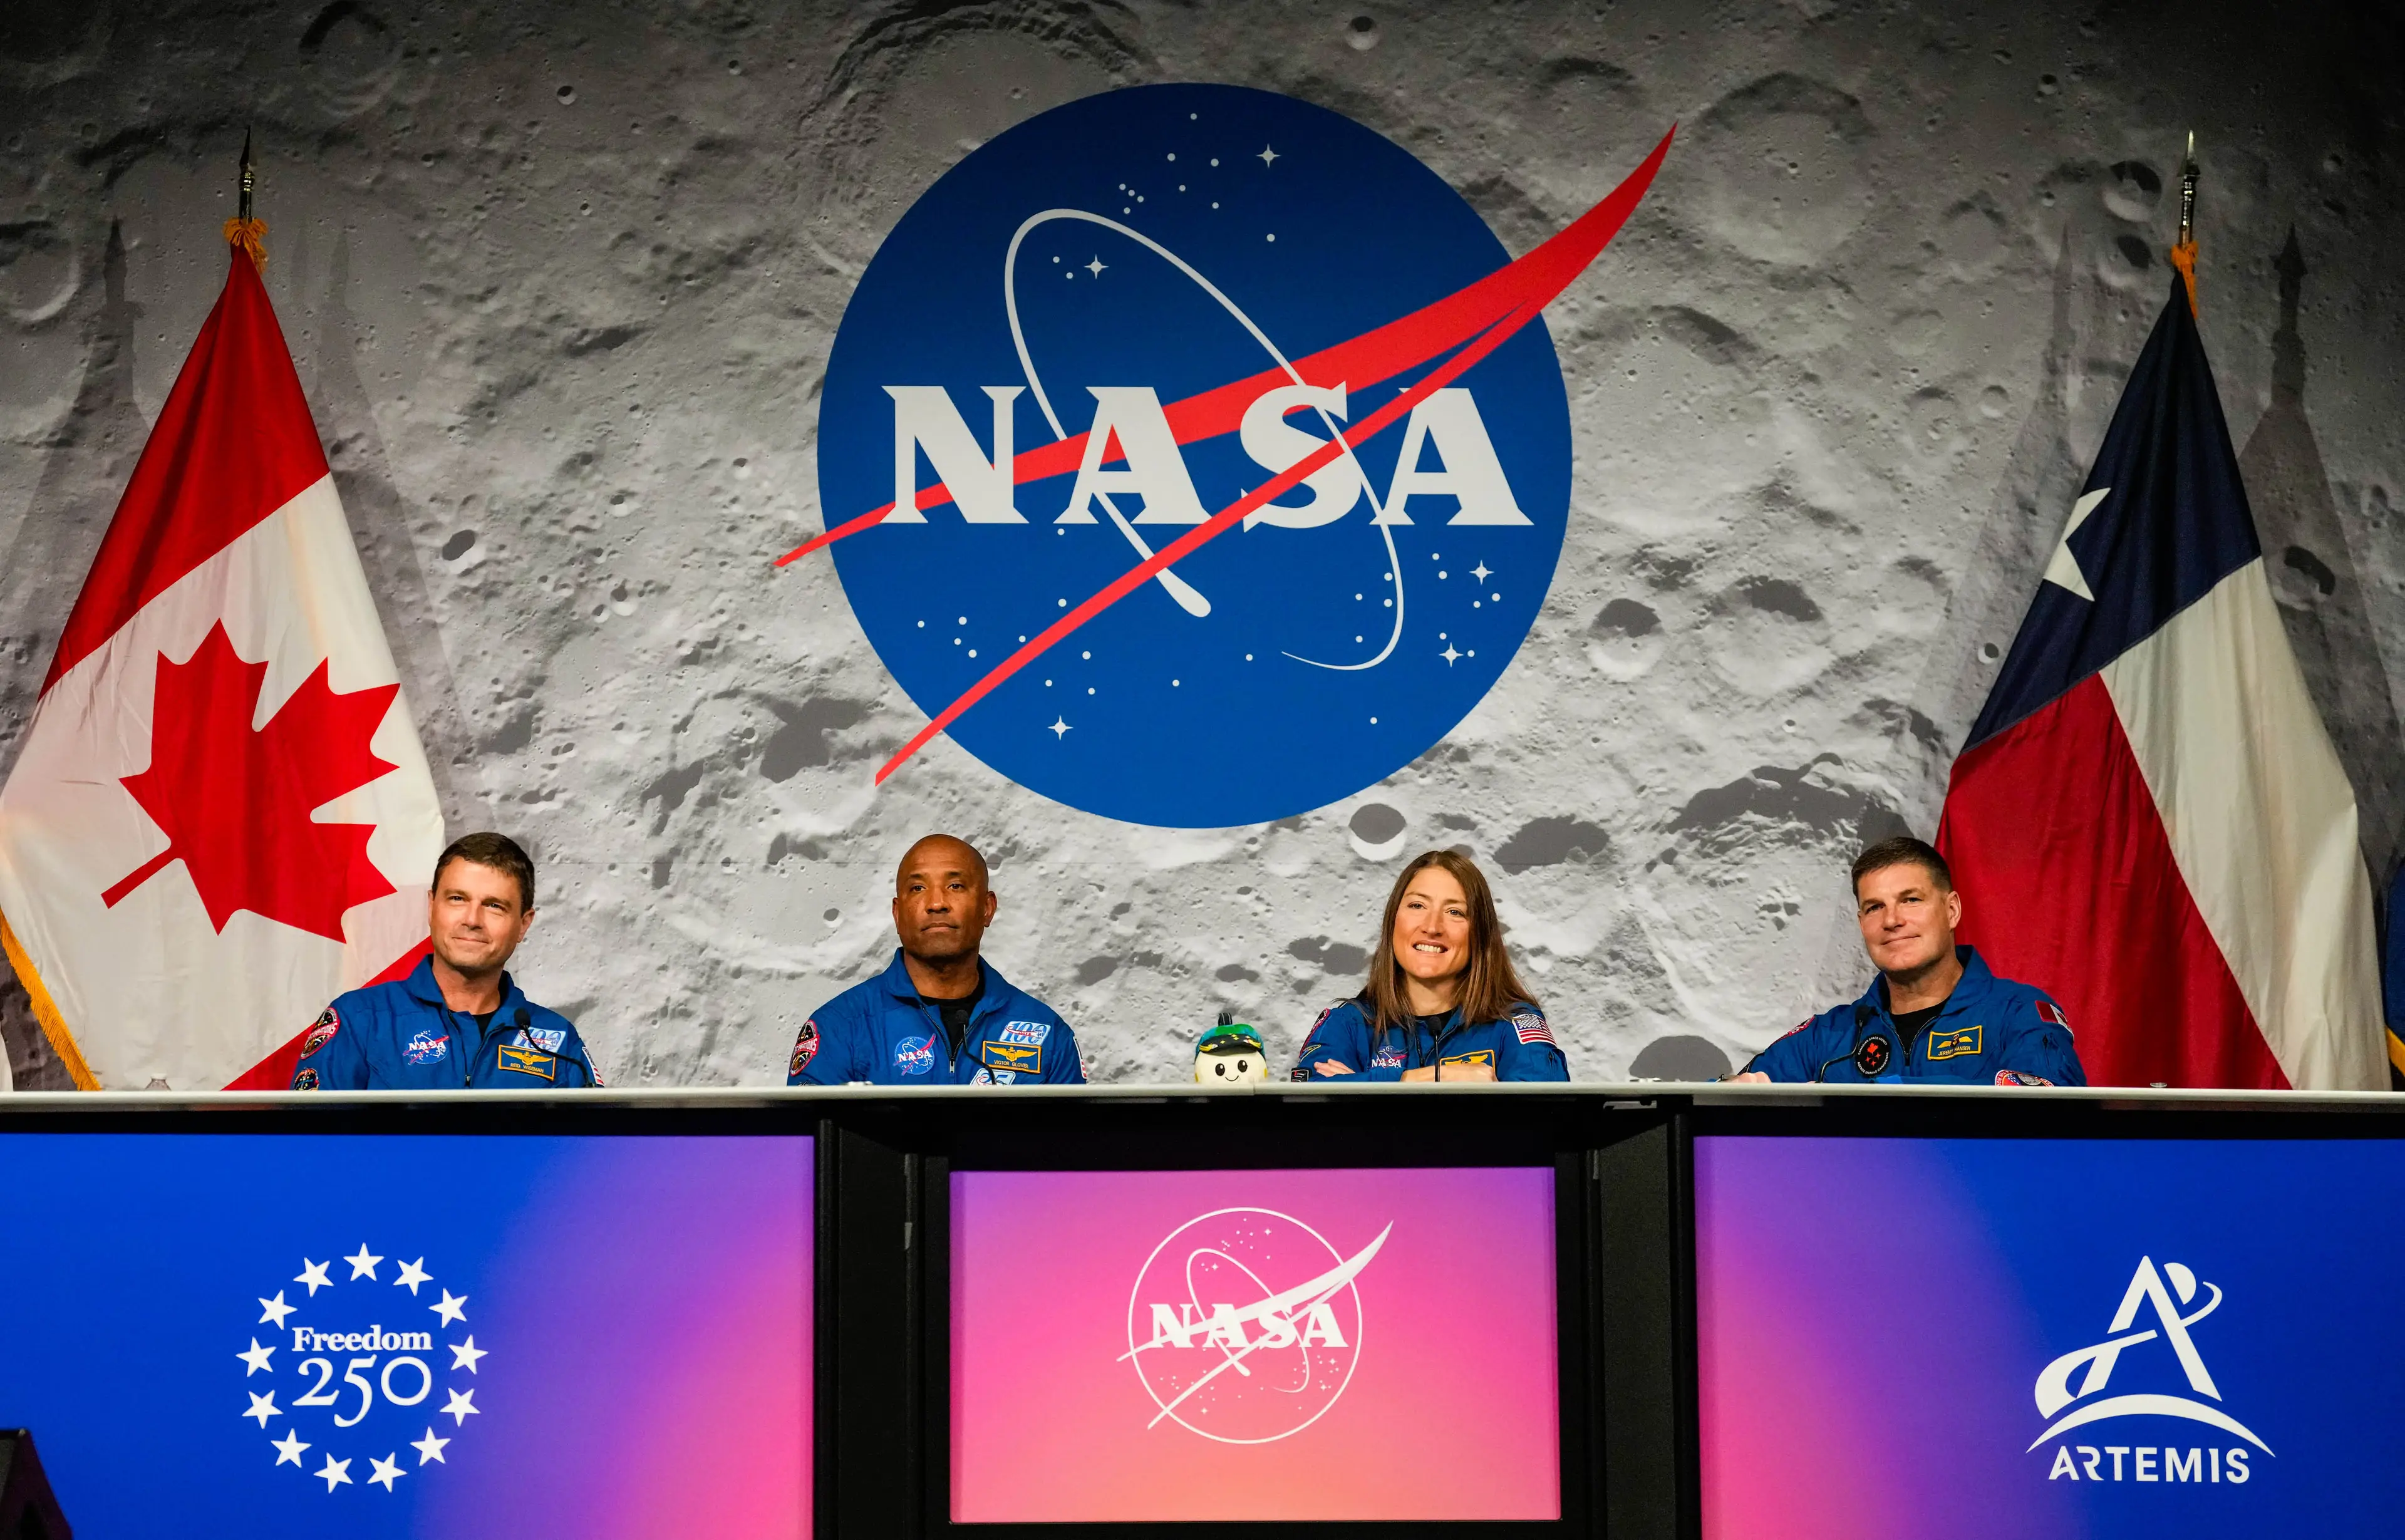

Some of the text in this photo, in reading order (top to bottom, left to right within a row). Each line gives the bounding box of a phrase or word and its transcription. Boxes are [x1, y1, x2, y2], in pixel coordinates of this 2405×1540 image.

[881, 381, 1534, 532] NASA
[1003, 1022, 1047, 1044] 100
[408, 1041, 447, 1051] NASA
[897, 1050, 933, 1062] NASA
[1858, 1040, 1869, 1055] CANADIAN
[1879, 1037, 1888, 1046] AGENCY
[523, 1065, 544, 1073] WISEMAN
[1371, 1058, 1402, 1068] NASA
[1858, 1062, 1866, 1073] AGENCE
[1877, 1052, 1889, 1072] CANADIENNE
[1149, 1303, 1349, 1350] NASA
[291, 1324, 433, 1352] Freedom
[291, 1353, 432, 1428] 250
[2048, 1445, 2250, 1484] ARTEMIS
